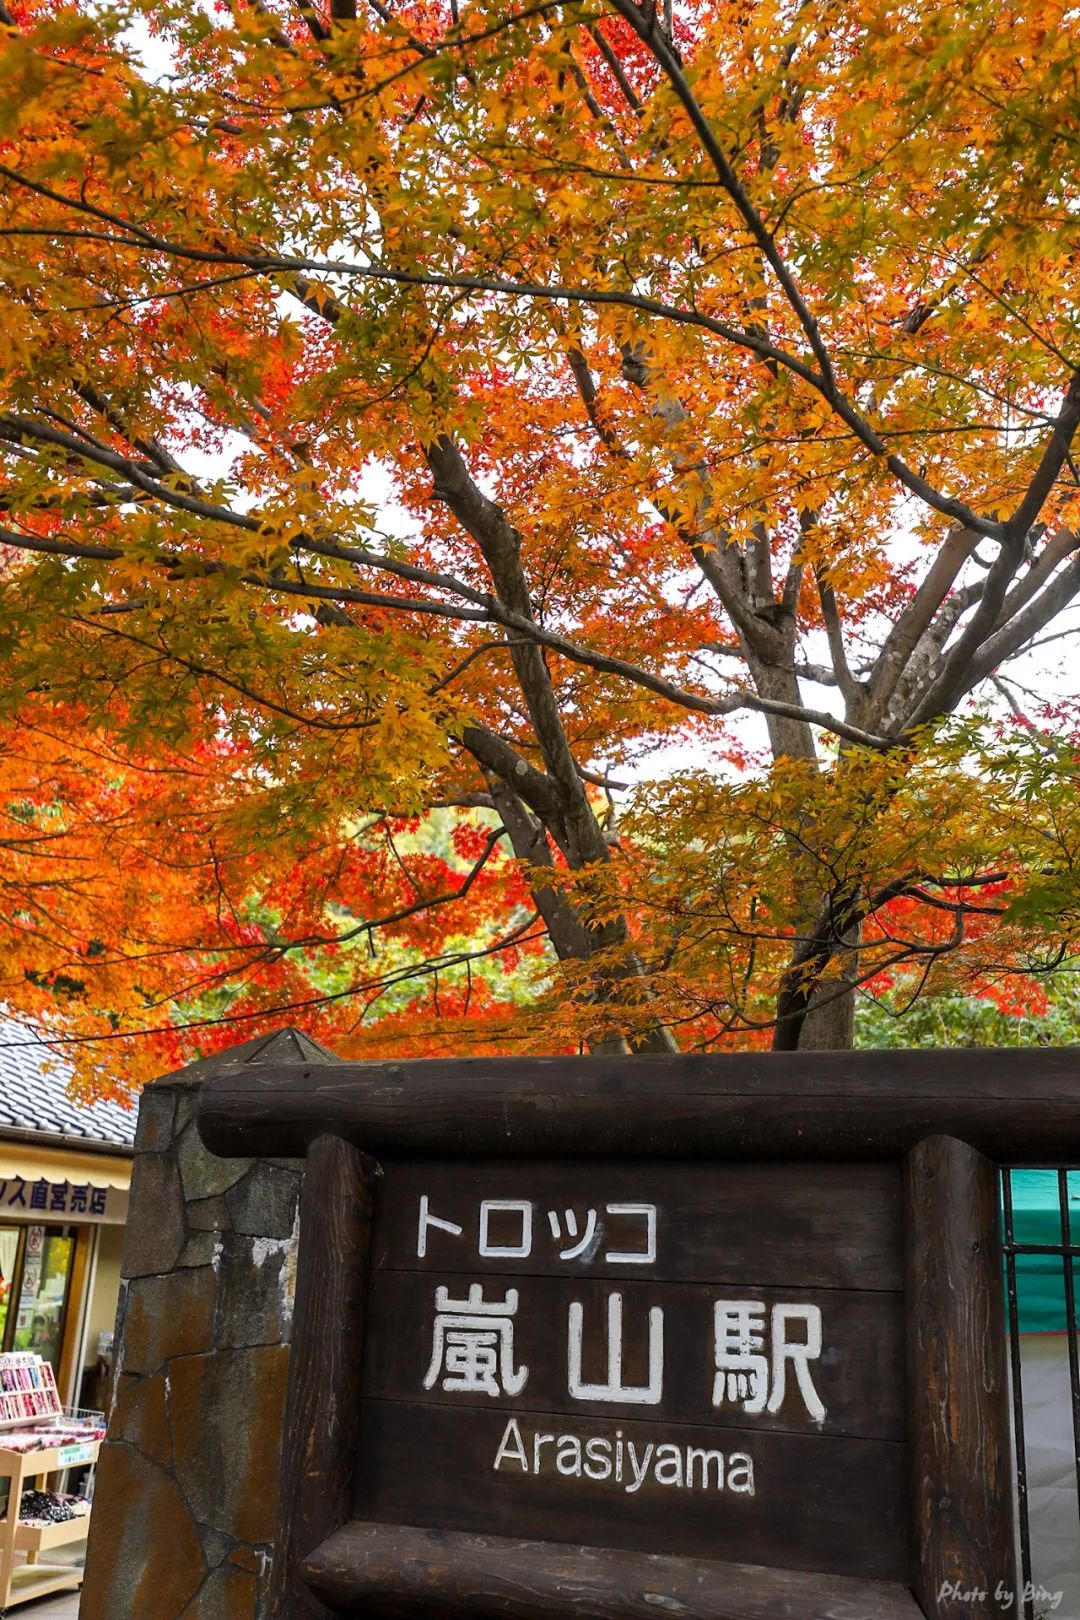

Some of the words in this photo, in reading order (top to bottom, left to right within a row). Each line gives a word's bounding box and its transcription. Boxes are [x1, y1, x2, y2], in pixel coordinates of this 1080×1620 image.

[417, 1195, 657, 1263] トロッコ
[422, 1283, 826, 1424] 嵐山駅
[493, 1418, 755, 1496] Arasiyama
